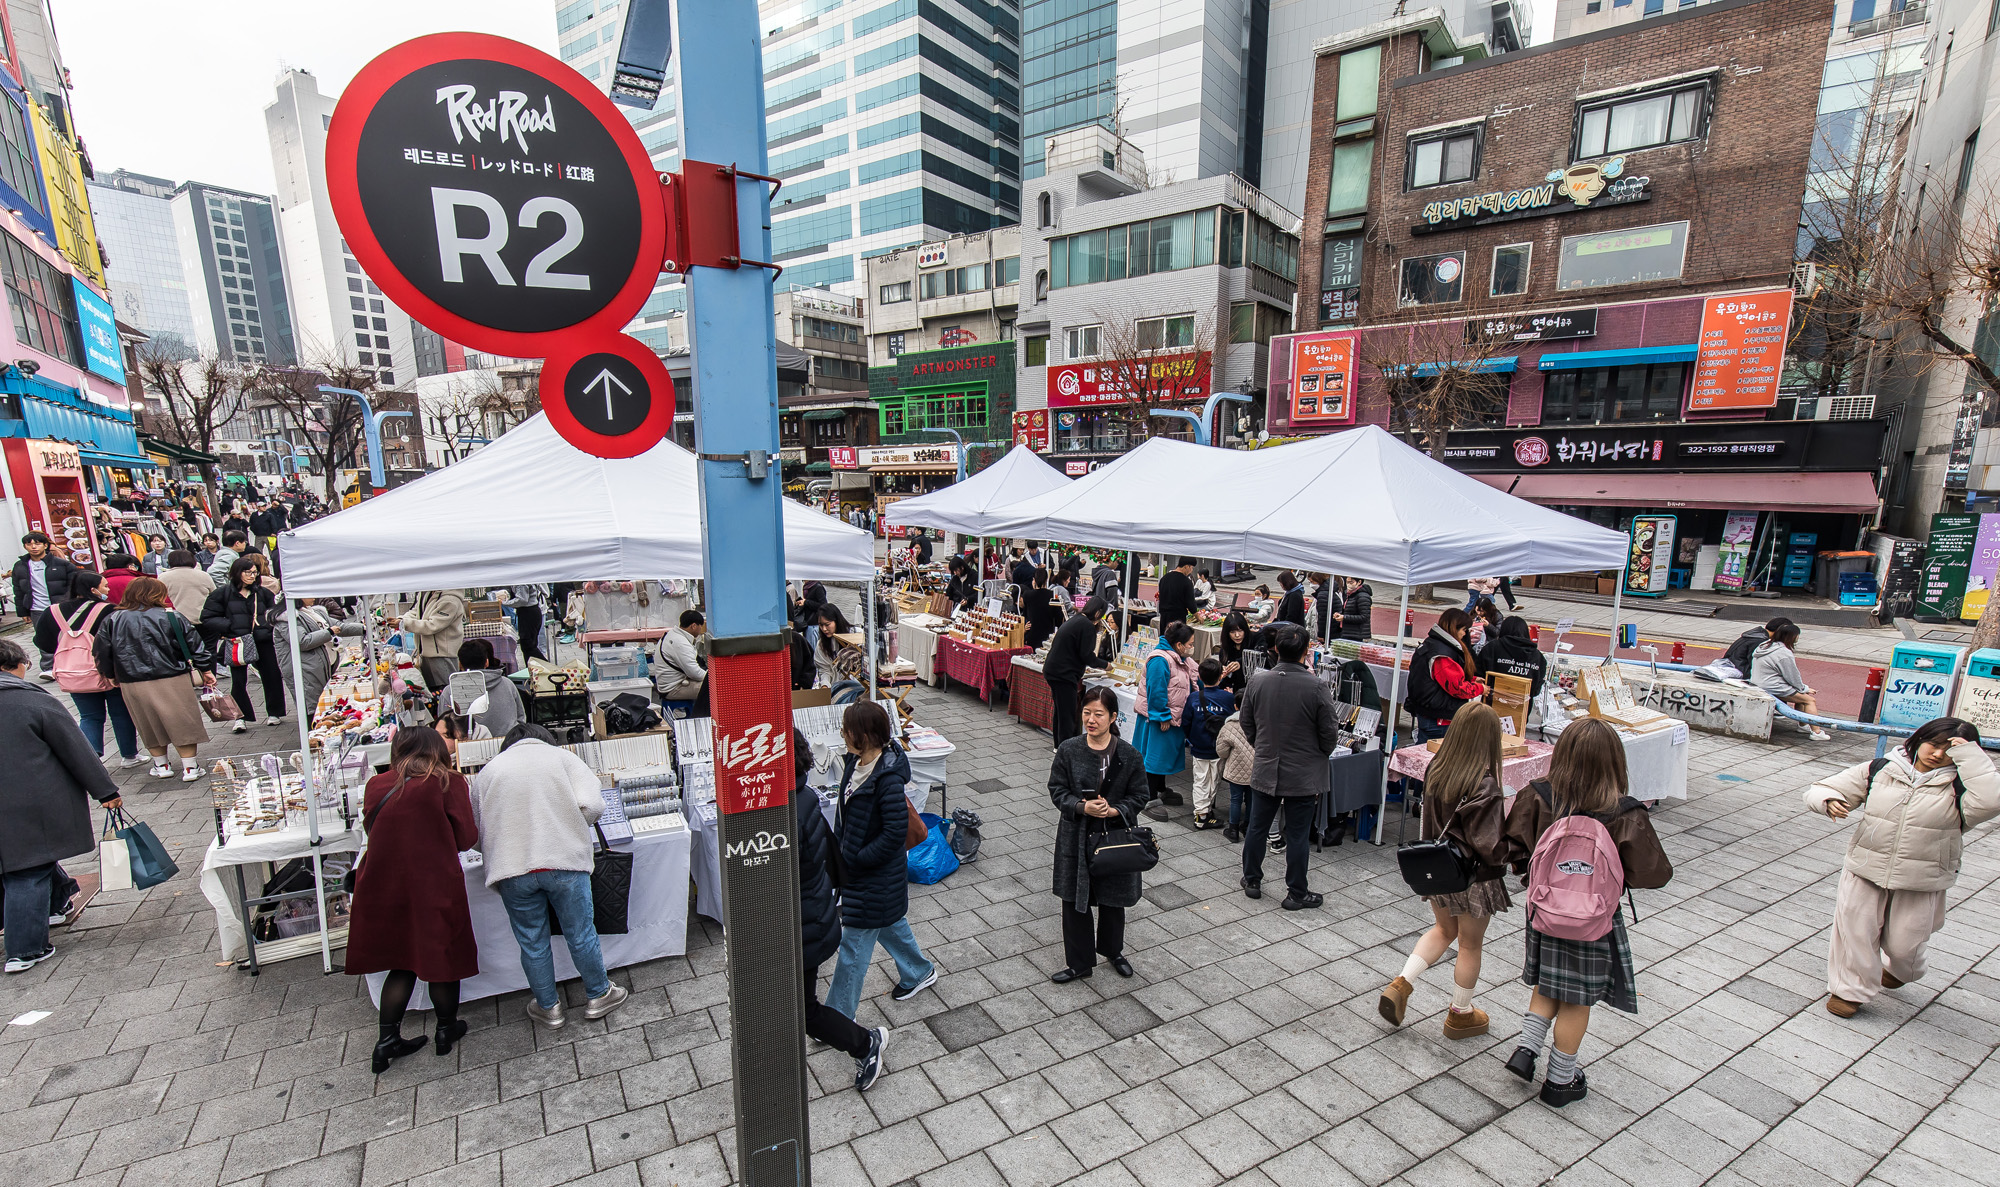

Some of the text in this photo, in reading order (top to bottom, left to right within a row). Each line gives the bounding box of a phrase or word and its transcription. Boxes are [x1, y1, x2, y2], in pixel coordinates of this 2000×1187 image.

[436, 84, 556, 155] Red Road
[404, 148, 467, 169] 레드로드
[566, 165, 595, 183] 红路
[431, 187, 591, 291] R2
[1330, 240, 1354, 287] 심리카페
[1322, 291, 1344, 305] 성격
[1329, 300, 1359, 320] 궁합
[1716, 302, 1757, 316] 육회왕자
[1532, 316, 1572, 331] 연어공주
[1736, 311, 1777, 325] 연어공주
[912, 355, 997, 376] ARTMONSTER
[1468, 449, 1496, 457] 무한리필
[1730, 445, 1776, 454] 홍대직영점
[1948, 560, 1969, 568] drinks
[1508, 666, 1530, 676] ADLV
[1886, 679, 1945, 697] STAND
[1639, 688, 1735, 717] 자유의지
[737, 772, 776, 786] Red Road
[740, 784, 772, 799] 赤い路
[725, 832, 790, 859] MAPO
[744, 856, 770, 868] 마포구
